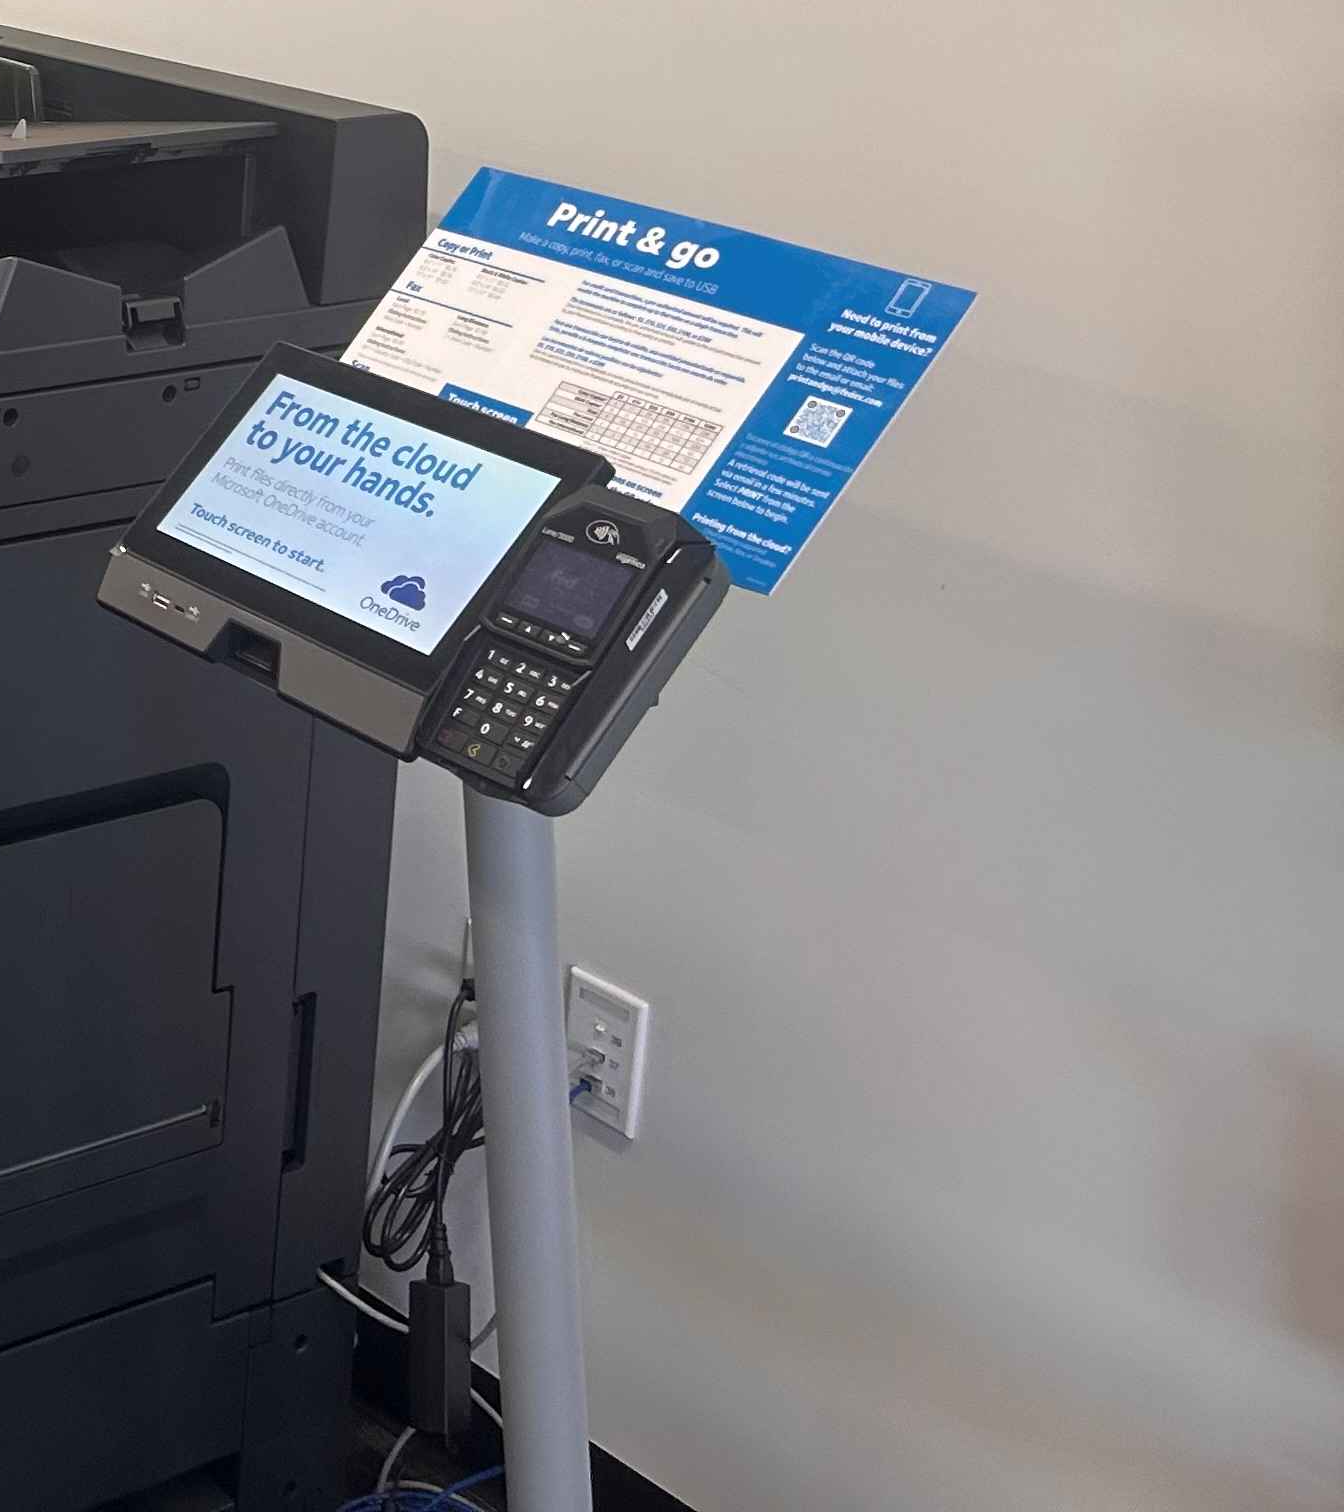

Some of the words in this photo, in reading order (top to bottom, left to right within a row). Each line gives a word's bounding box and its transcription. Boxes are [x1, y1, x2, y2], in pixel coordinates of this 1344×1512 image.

[437, 238, 461, 256] Copy
[469, 246, 493, 261] Print
[546, 202, 637, 246] Print
[635, 226, 666, 255] &
[665, 240, 720, 269] go
[518, 230, 541, 246] Make
[548, 241, 569, 257] copy,
[569, 245, 593, 263] print,
[612, 258, 622, 268] or
[623, 261, 644, 274] scan
[645, 265, 663, 280] and
[663, 272, 684, 286] save
[685, 276, 696, 288] to
[695, 279, 719, 295] USB
[406, 280, 422, 293] Fax
[827, 323, 854, 337] your
[854, 327, 890, 347] mobile
[890, 338, 933, 357] device?
[841, 308, 871, 325] Need
[870, 317, 882, 328] to
[879, 321, 911, 336] print
[910, 327, 937, 343] from
[802, 353, 825, 366] below
[826, 358, 843, 371] and
[842, 364, 868, 379] attach
[866, 373, 886, 385] your
[885, 378, 905, 390] files
[806, 365, 818, 375] the
[818, 370, 840, 384] email
[809, 343, 829, 355] Scan
[830, 348, 841, 358] the
[842, 352, 856, 363] QR
[856, 358, 876, 368] code
[449, 392, 480, 411] Touch
[480, 405, 518, 424] screen
[265, 390, 340, 439] From
[340, 419, 391, 458] the
[392, 441, 483, 491] cloud
[246, 419, 278, 450] to
[271, 438, 346, 478] your
[347, 458, 435, 518] hands.
[210, 472, 264, 506] Microsoft
[262, 492, 317, 531] OneDrive
[222, 457, 253, 480] Print
[250, 467, 275, 489] files
[273, 478, 322, 508] directly
[318, 495, 347, 517] from
[344, 507, 376, 529] your
[190, 502, 228, 529] Touch
[227, 521, 272, 549] screen
[272, 538, 289, 555] to
[288, 544, 325, 573] start.
[691, 512, 726, 533] Printing
[726, 524, 747, 539] from
[746, 532, 762, 545] the
[761, 539, 792, 555] cloud?
[359, 595, 421, 633] OneDrive
